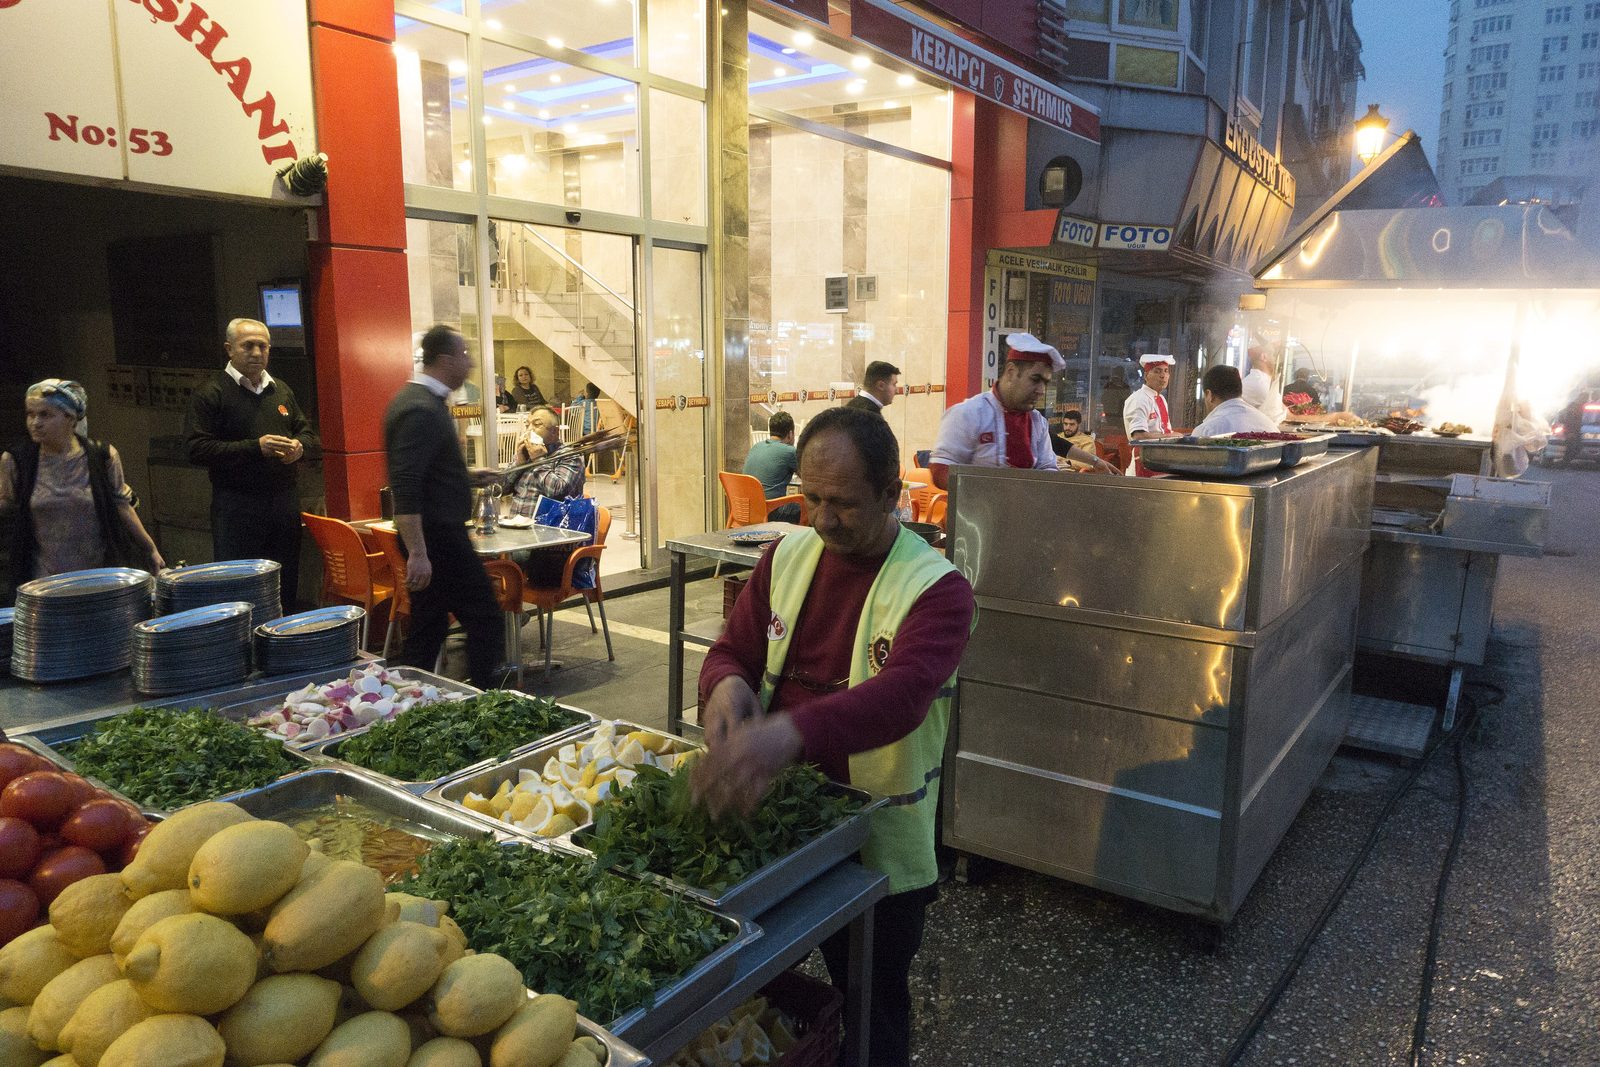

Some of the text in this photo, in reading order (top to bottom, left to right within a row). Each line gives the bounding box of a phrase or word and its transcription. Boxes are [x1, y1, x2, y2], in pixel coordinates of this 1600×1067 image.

[911, 28, 1074, 128] KEBAPÇI ŞEYHMUS
[44, 111, 173, 156] No: 53
[1060, 220, 1093, 244] FOTO
[1105, 225, 1170, 245] FOTO
[999, 255, 1025, 267] ACELE
[988, 279, 996, 368] FOTO
